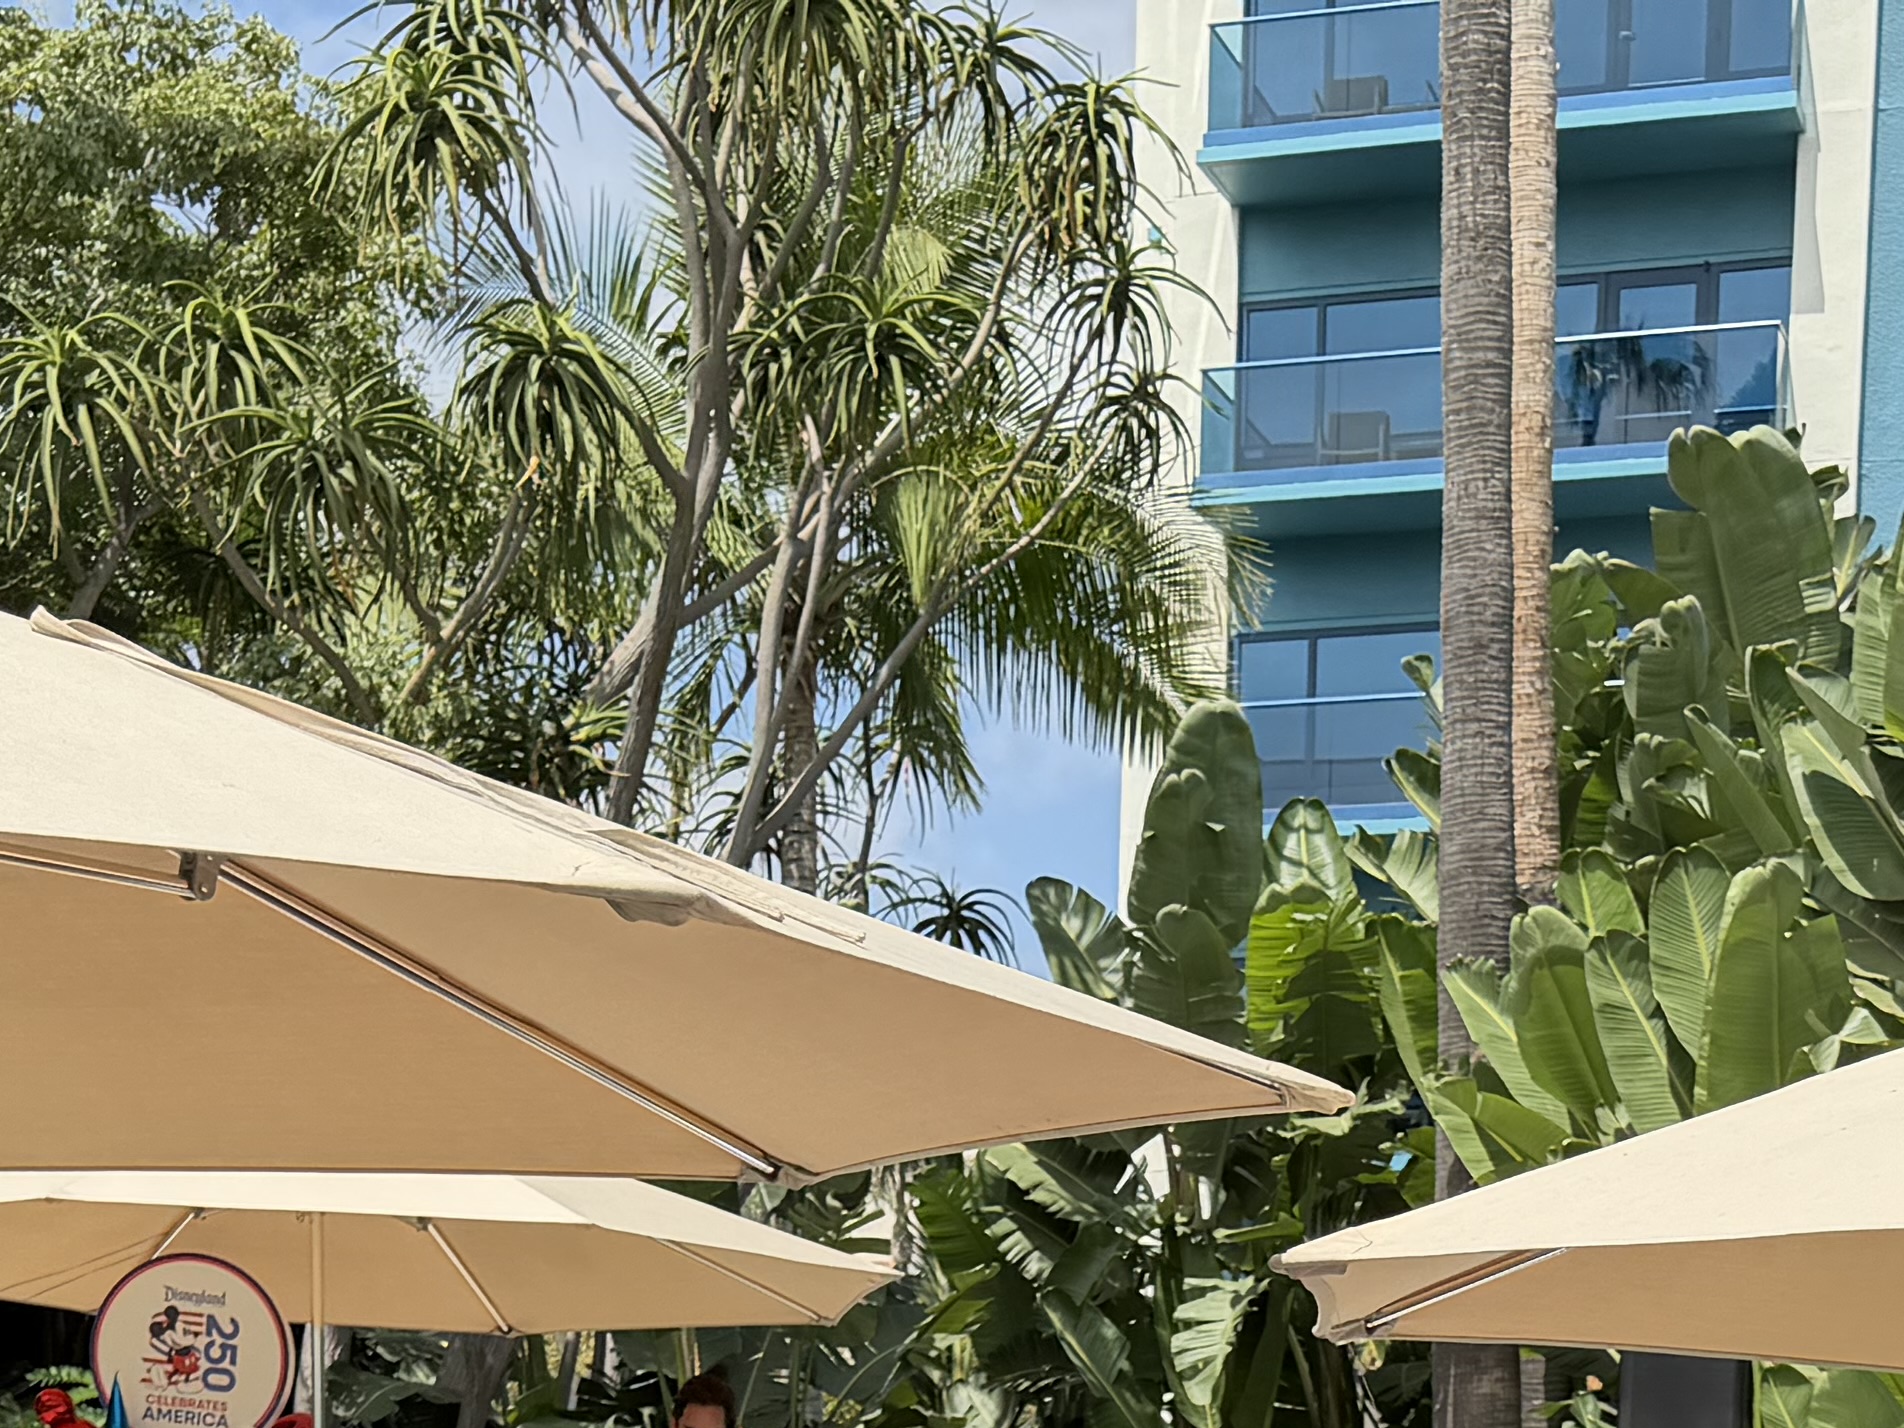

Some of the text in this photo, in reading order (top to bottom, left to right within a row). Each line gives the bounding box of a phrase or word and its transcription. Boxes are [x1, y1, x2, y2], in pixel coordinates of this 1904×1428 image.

[202, 1313, 240, 1393] 250
[145, 1394, 228, 1412] CELEBRATES
[141, 1406, 229, 1428] AMERICA
